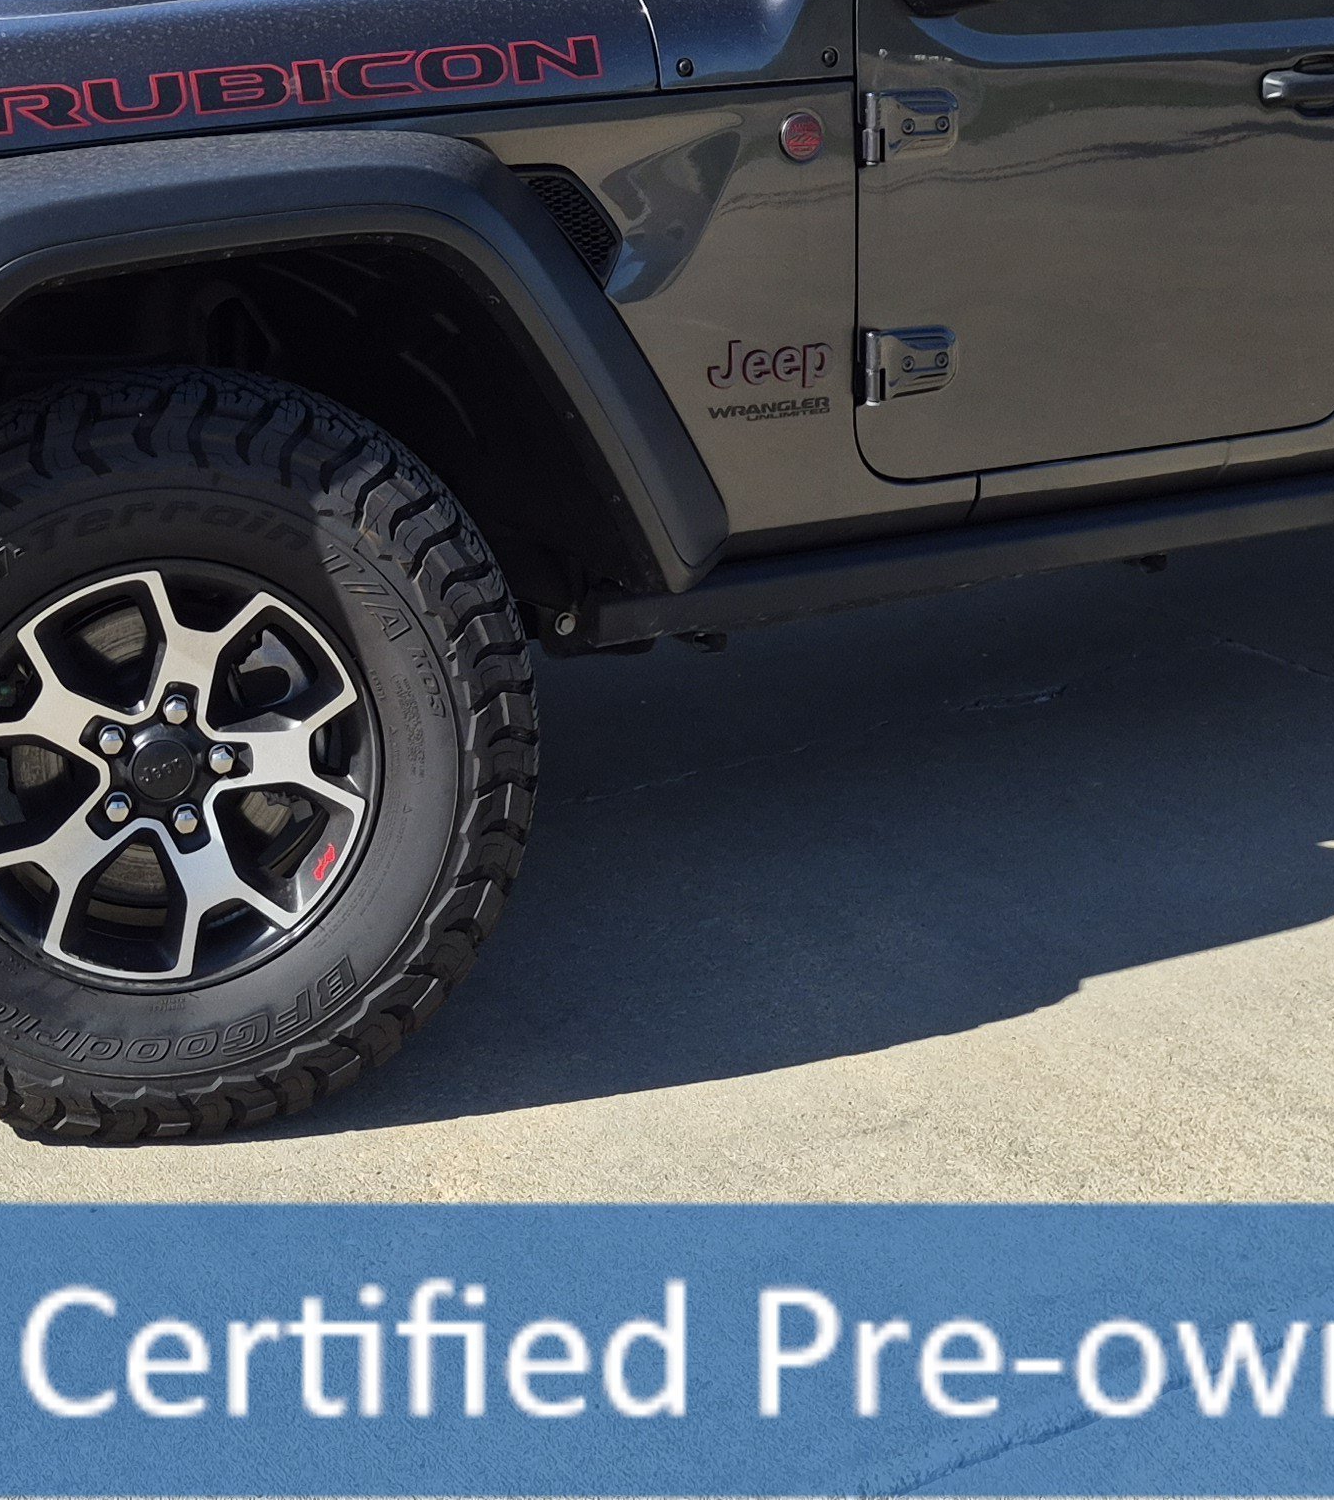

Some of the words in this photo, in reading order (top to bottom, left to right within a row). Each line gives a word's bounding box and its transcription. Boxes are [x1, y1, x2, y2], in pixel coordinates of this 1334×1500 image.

[707, 339, 834, 389] Jeep
[707, 396, 831, 419] WRANGLER
[746, 407, 831, 421] UNLIMITED
